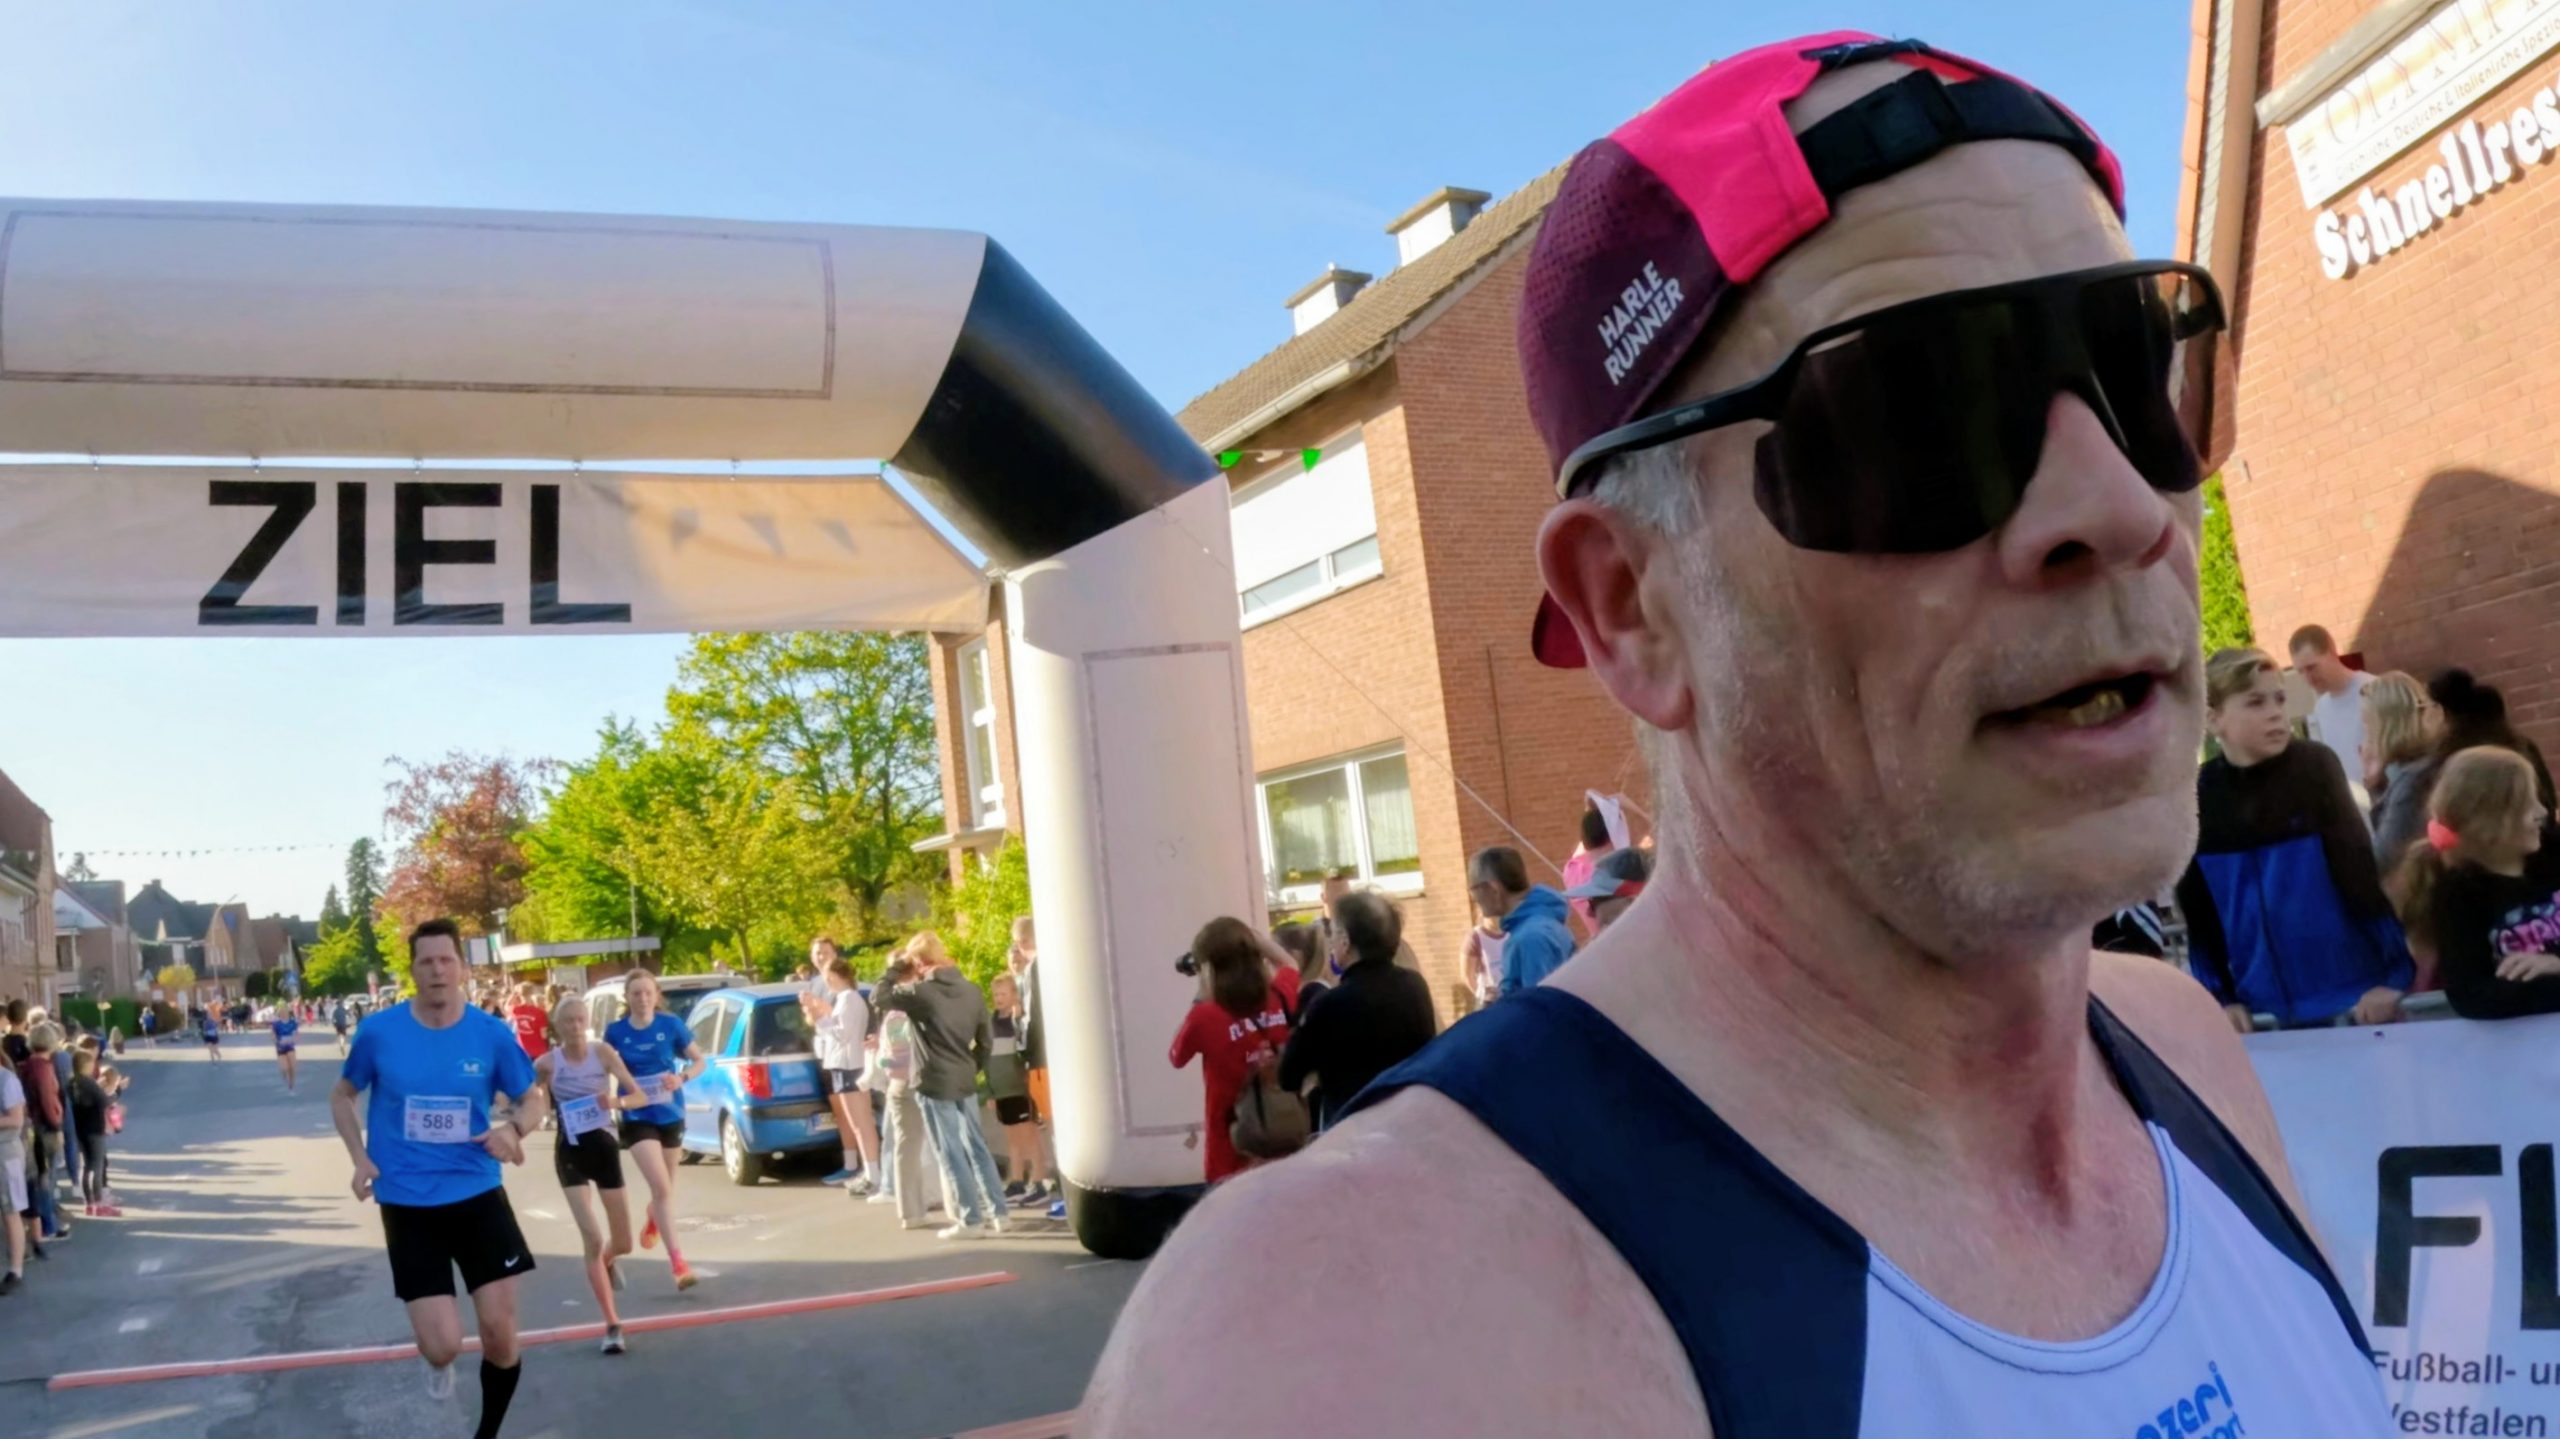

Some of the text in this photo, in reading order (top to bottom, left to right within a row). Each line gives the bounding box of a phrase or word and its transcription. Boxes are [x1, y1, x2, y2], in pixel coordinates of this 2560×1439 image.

[2324, 0, 2540, 146] OLYM
[2314, 70, 2560, 280] Schnellres
[1598, 260, 1663, 348] HARLE
[1603, 278, 1685, 386] RUNNER
[198, 480, 632, 625] ZIEL
[422, 1113, 454, 1129] 588
[2392, 1403, 2546, 1438] estfalen
